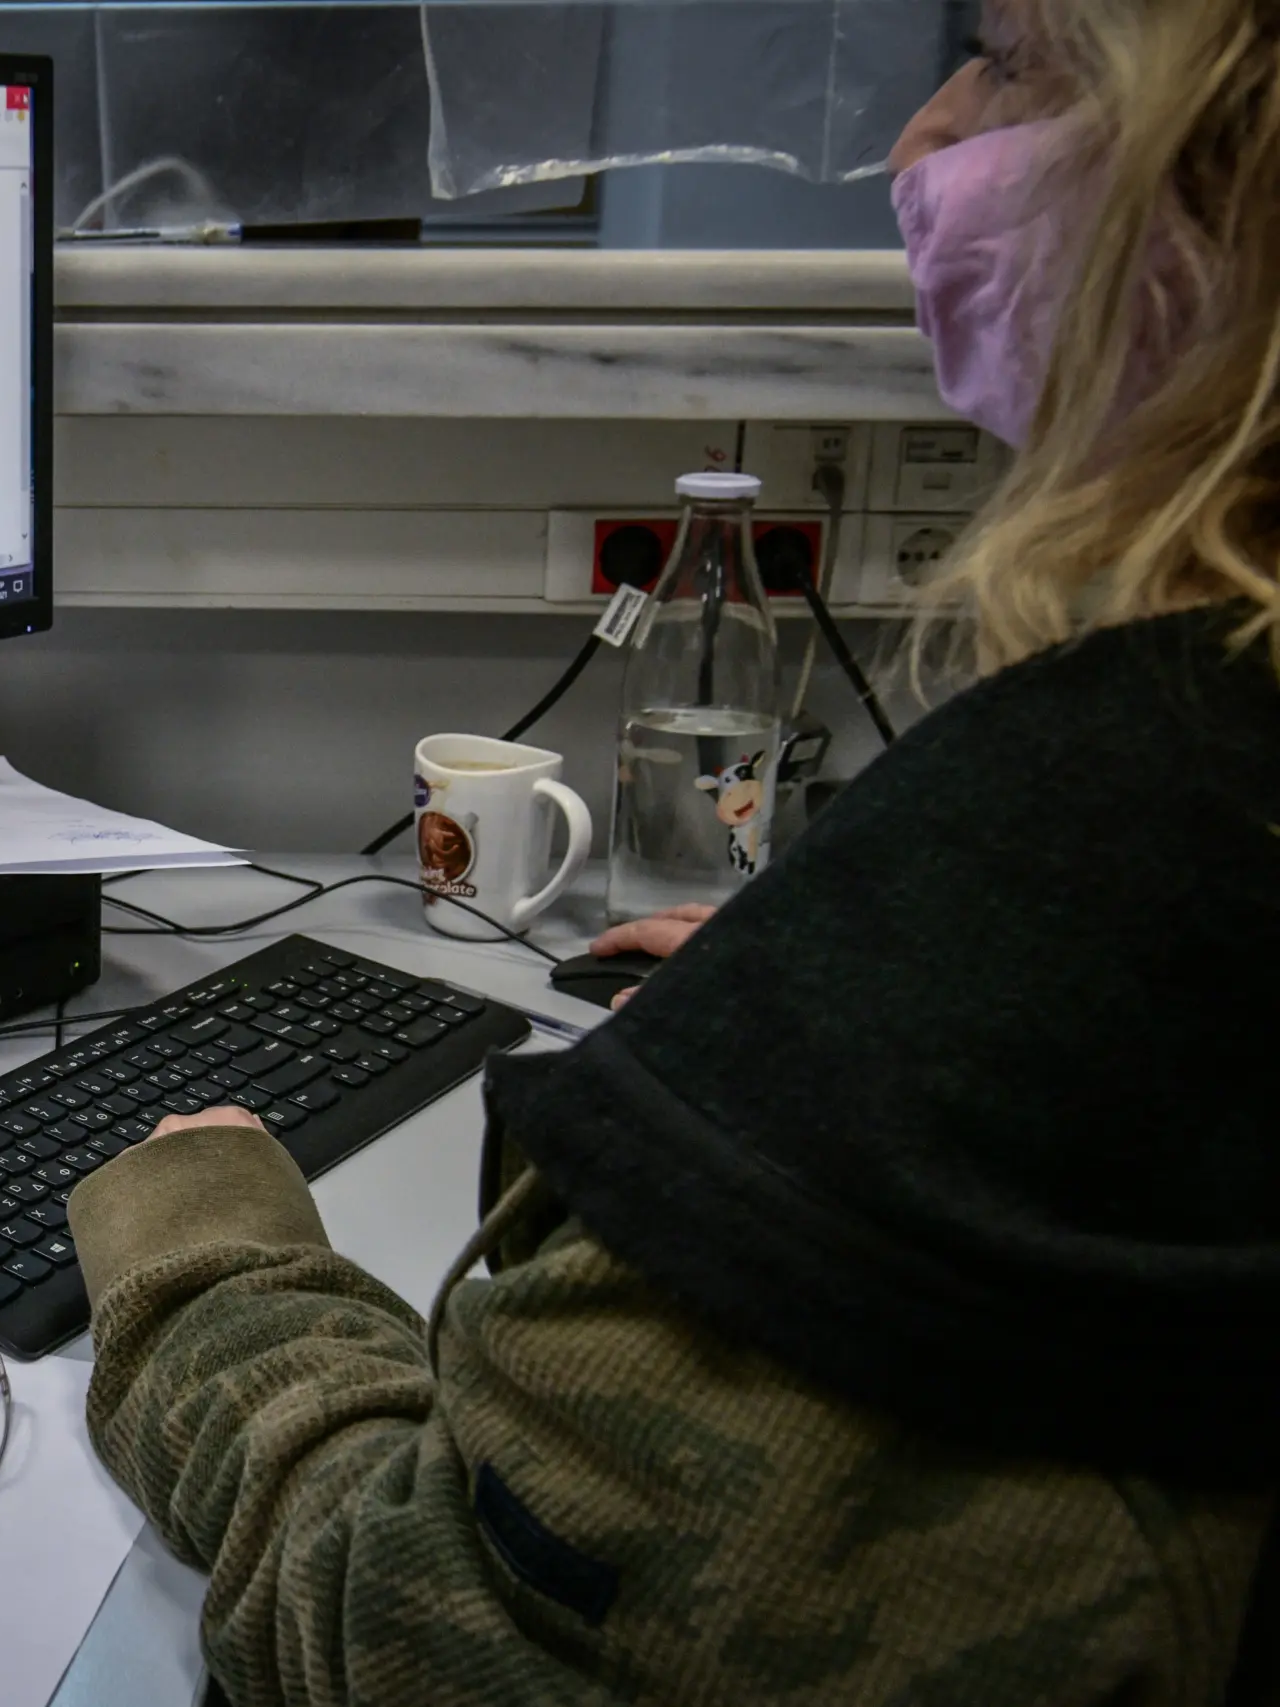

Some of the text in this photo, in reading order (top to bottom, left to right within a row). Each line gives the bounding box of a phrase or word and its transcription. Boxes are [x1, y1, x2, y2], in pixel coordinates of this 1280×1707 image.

[65, 1154, 78, 1162] G
[9, 1185, 22, 1193] D
[31, 1209, 46, 1218] X
[2, 1226, 17, 1235] Z
[12, 1263, 24, 1271] Fn
